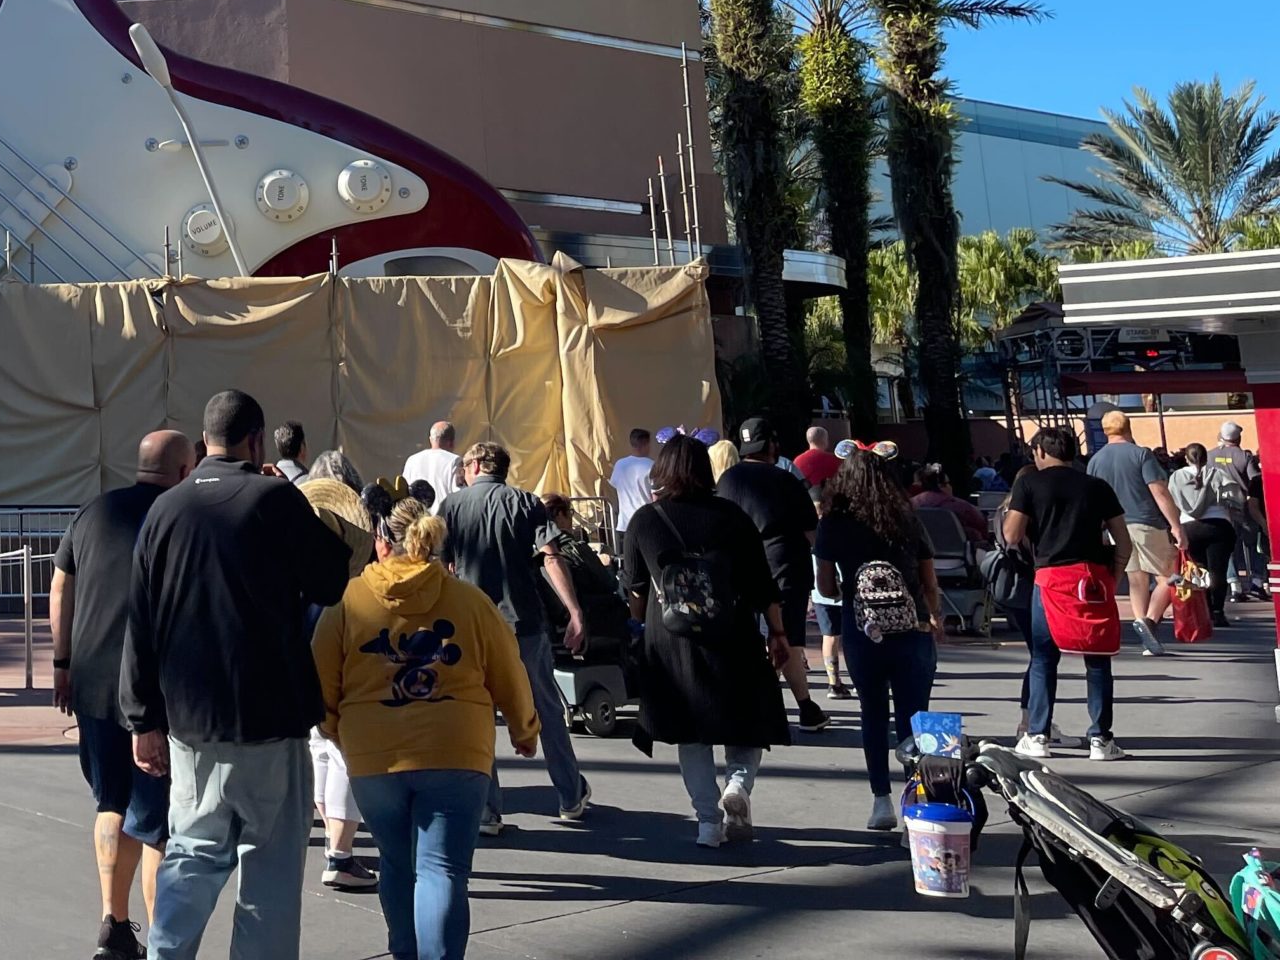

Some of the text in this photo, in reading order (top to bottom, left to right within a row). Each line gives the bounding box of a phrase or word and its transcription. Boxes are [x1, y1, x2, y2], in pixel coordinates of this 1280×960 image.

[360, 175, 368, 192] TONE
[277, 185, 285, 201] TONE
[191, 219, 217, 235] VOLUME
